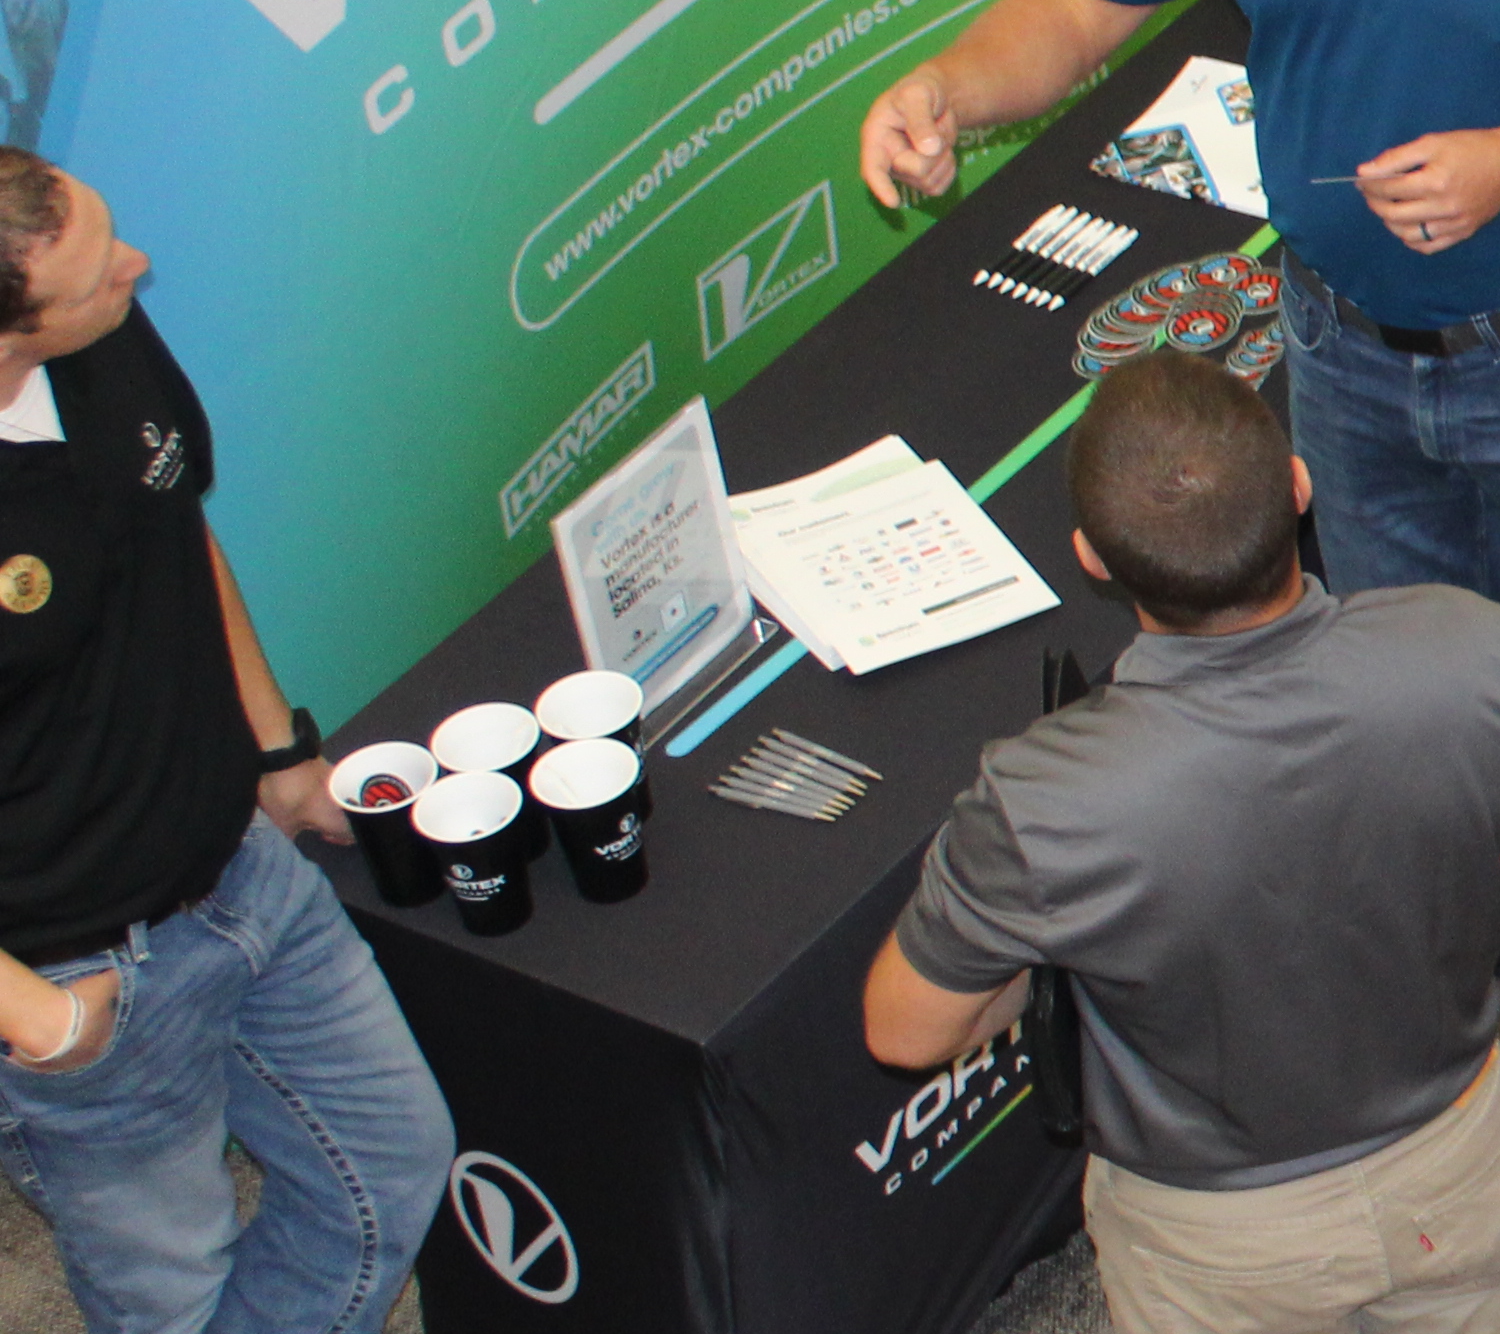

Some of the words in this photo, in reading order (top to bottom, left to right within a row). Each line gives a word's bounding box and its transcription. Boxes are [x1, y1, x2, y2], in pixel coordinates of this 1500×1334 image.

[508, 369, 650, 519] HAMAR
[600, 525, 648, 569] Vortex
[604, 498, 700, 587] manufacturer
[609, 546, 664, 603] located
[664, 536, 681, 553] in
[612, 576, 663, 619] Salina,
[855, 1019, 1023, 1172] VORT
